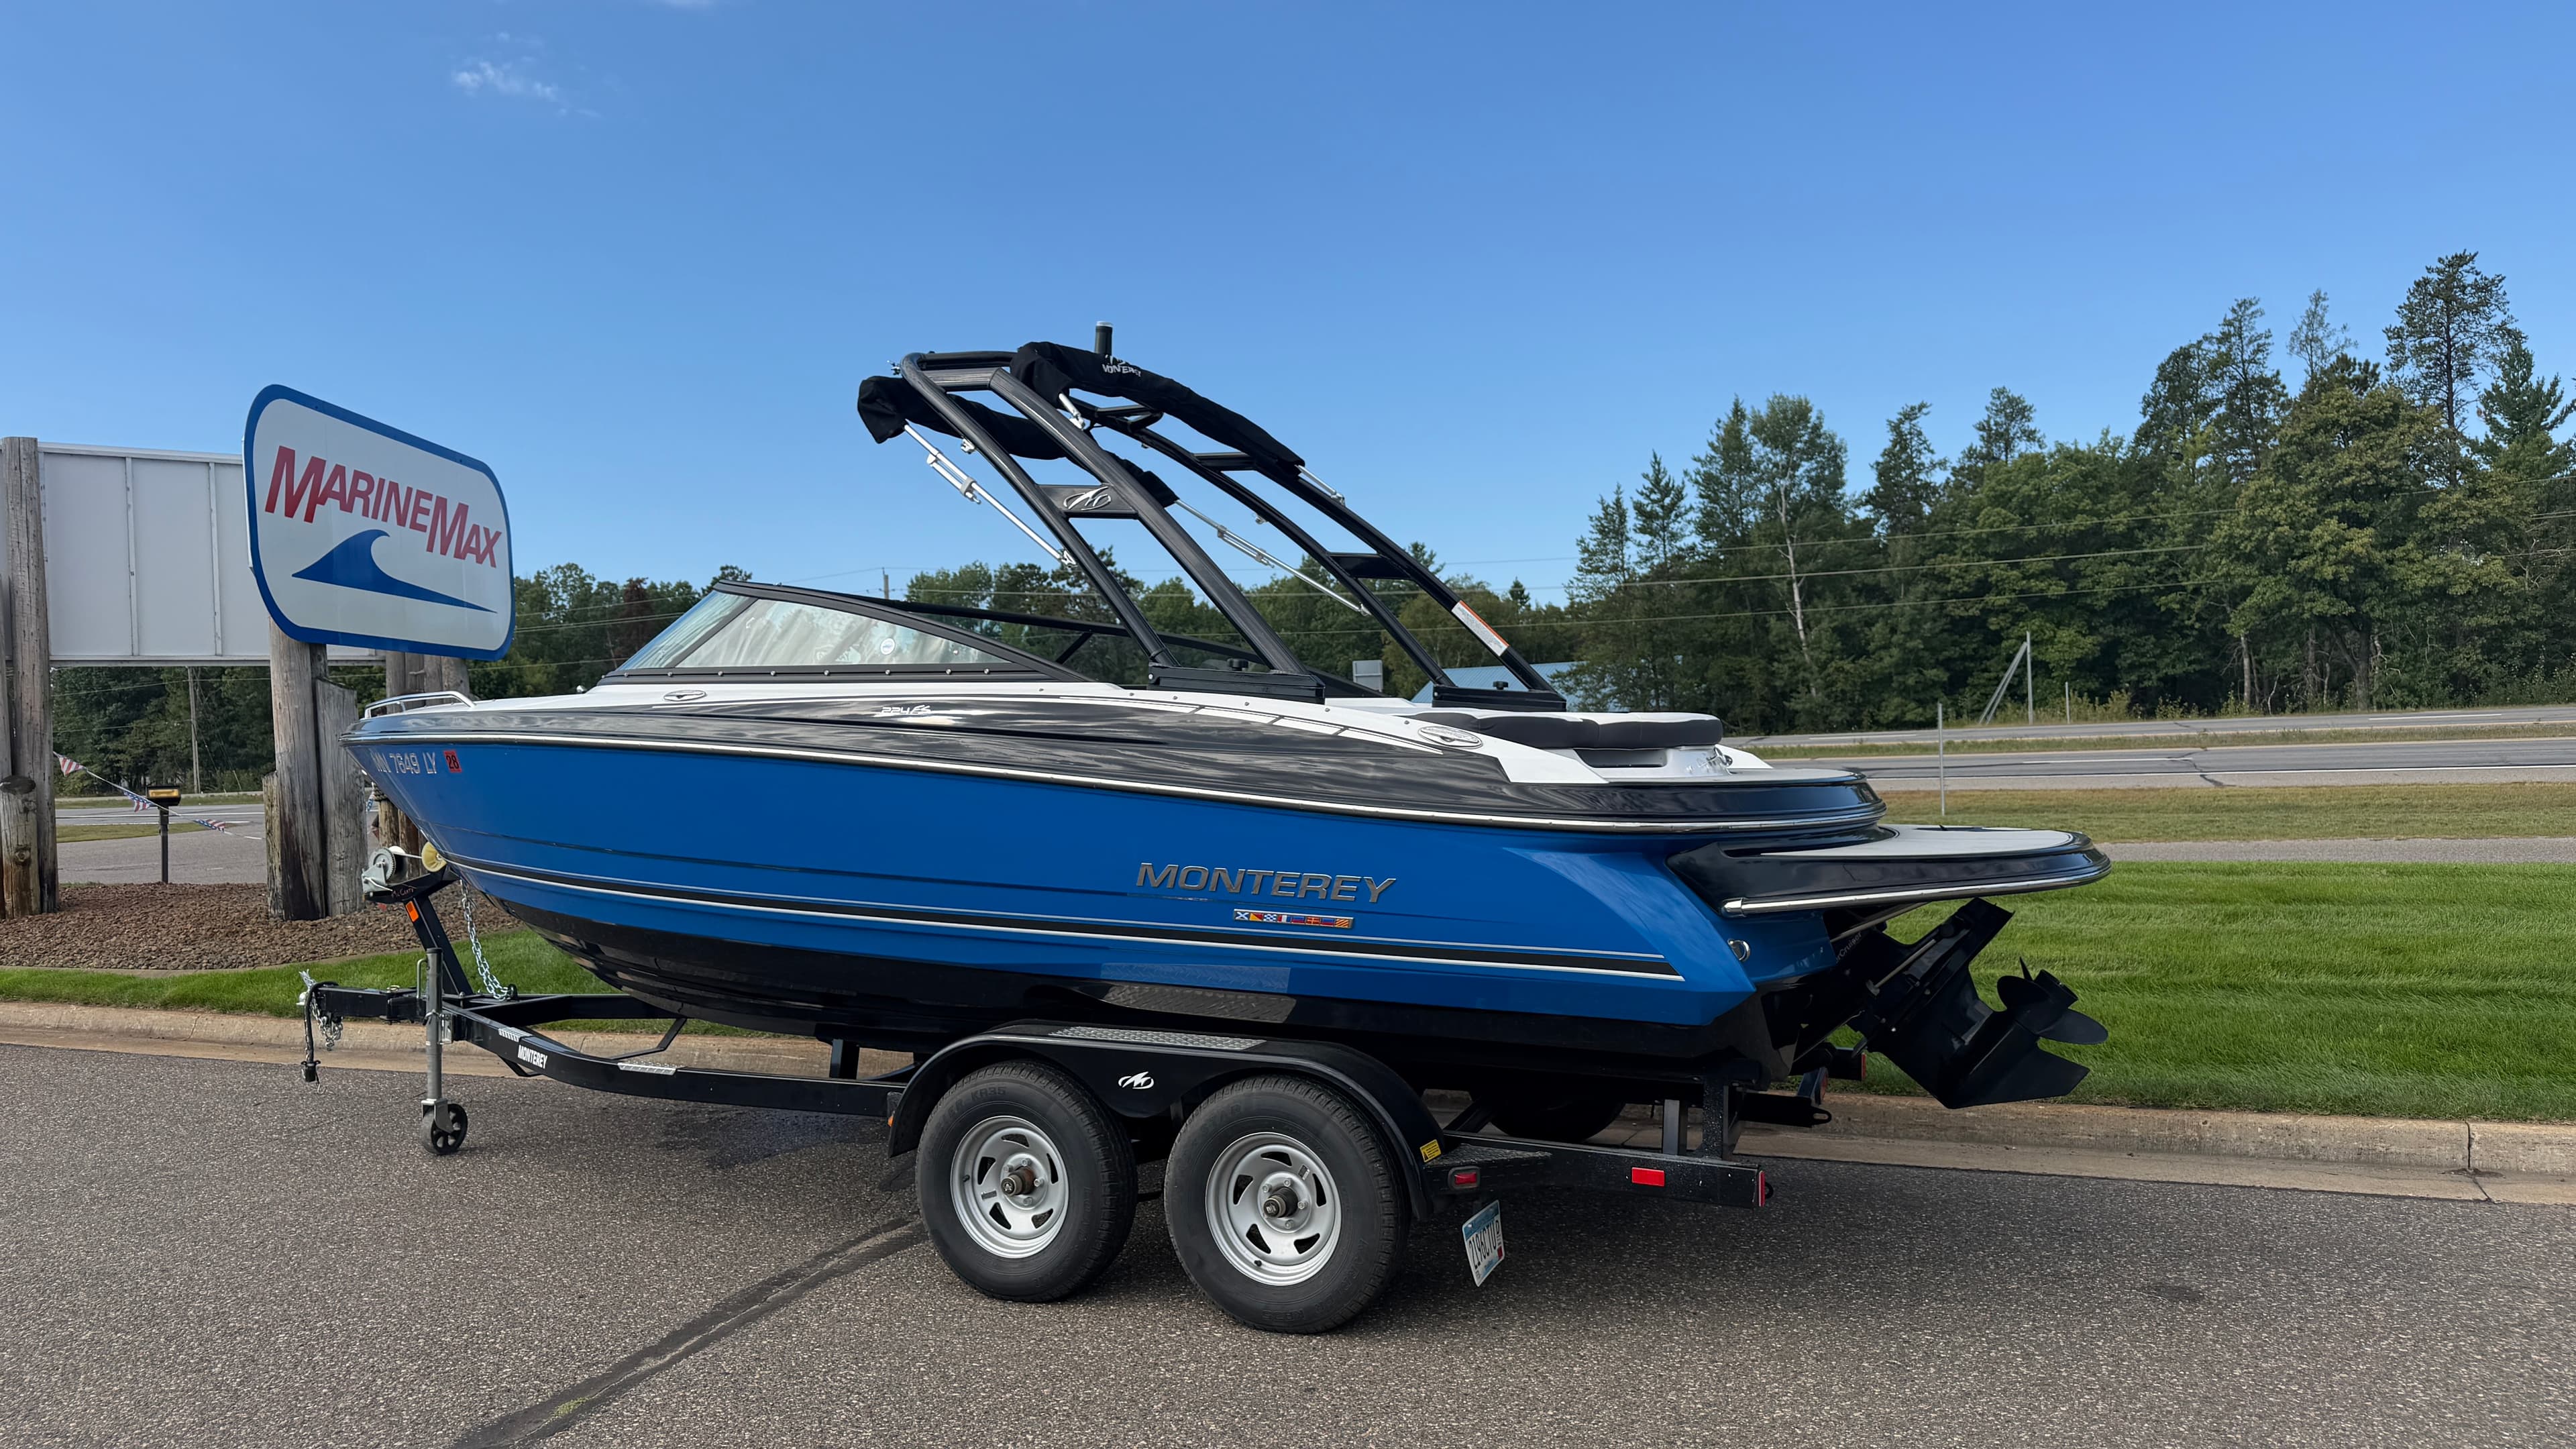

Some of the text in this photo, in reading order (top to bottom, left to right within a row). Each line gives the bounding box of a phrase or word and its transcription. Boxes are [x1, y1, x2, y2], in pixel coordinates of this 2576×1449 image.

[390, 753, 421, 773] 7649
[423, 752, 437, 773] LY
[445, 755, 460, 769] 28
[1136, 863, 1396, 904] MONTEREY
[518, 1044, 547, 1069] MONTEREY
